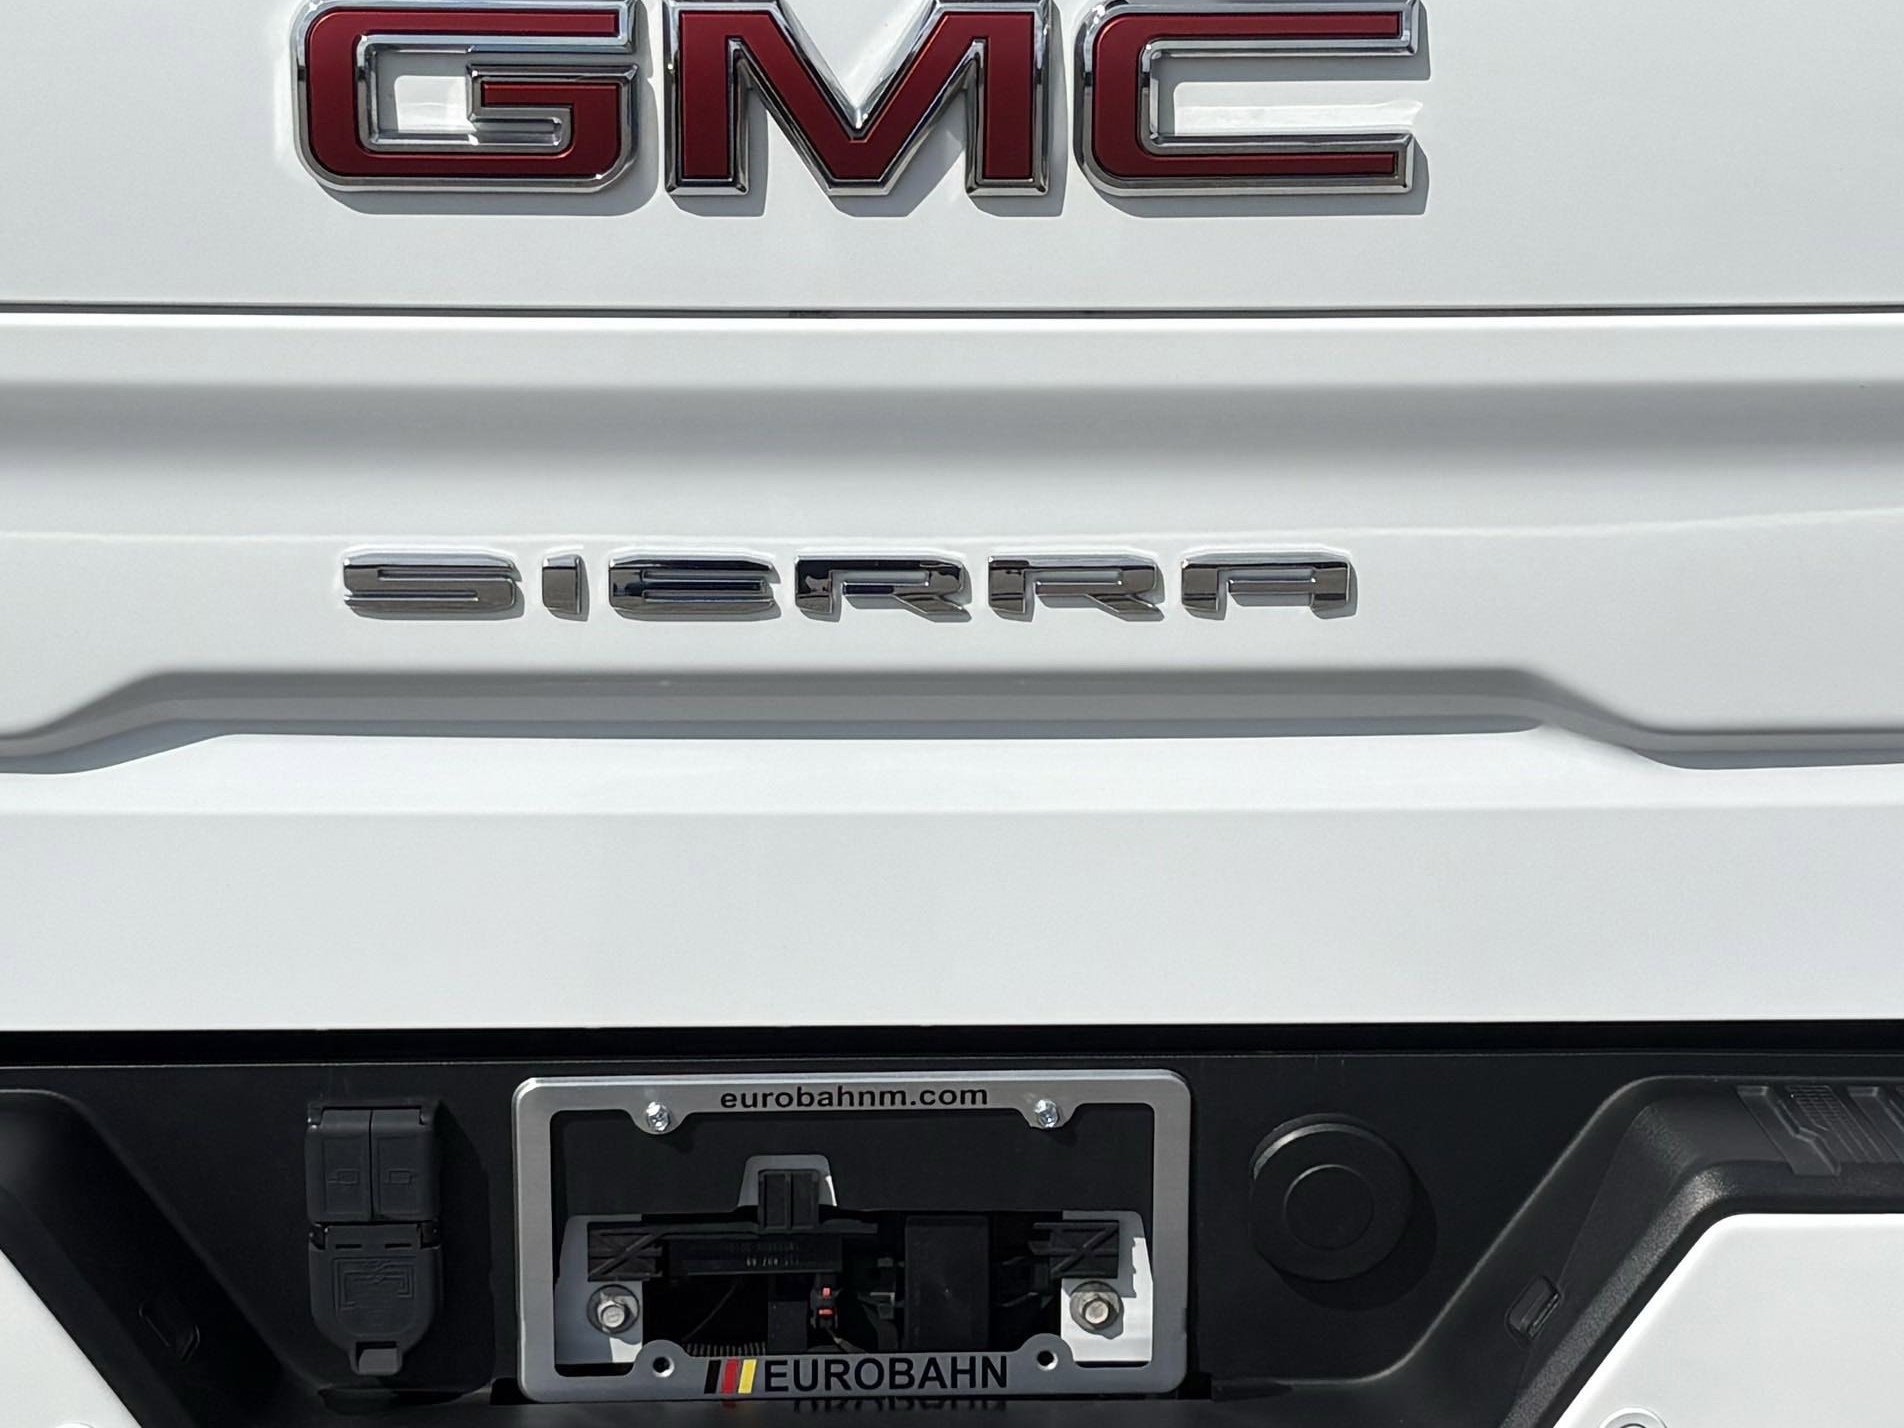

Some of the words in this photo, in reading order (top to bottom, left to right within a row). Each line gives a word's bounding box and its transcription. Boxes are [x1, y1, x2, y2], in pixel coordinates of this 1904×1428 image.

[342, 550, 1353, 621] SIERRA
[719, 1085, 989, 1109] eurobahnm.com
[764, 1355, 1008, 1392] EUROBAHN
